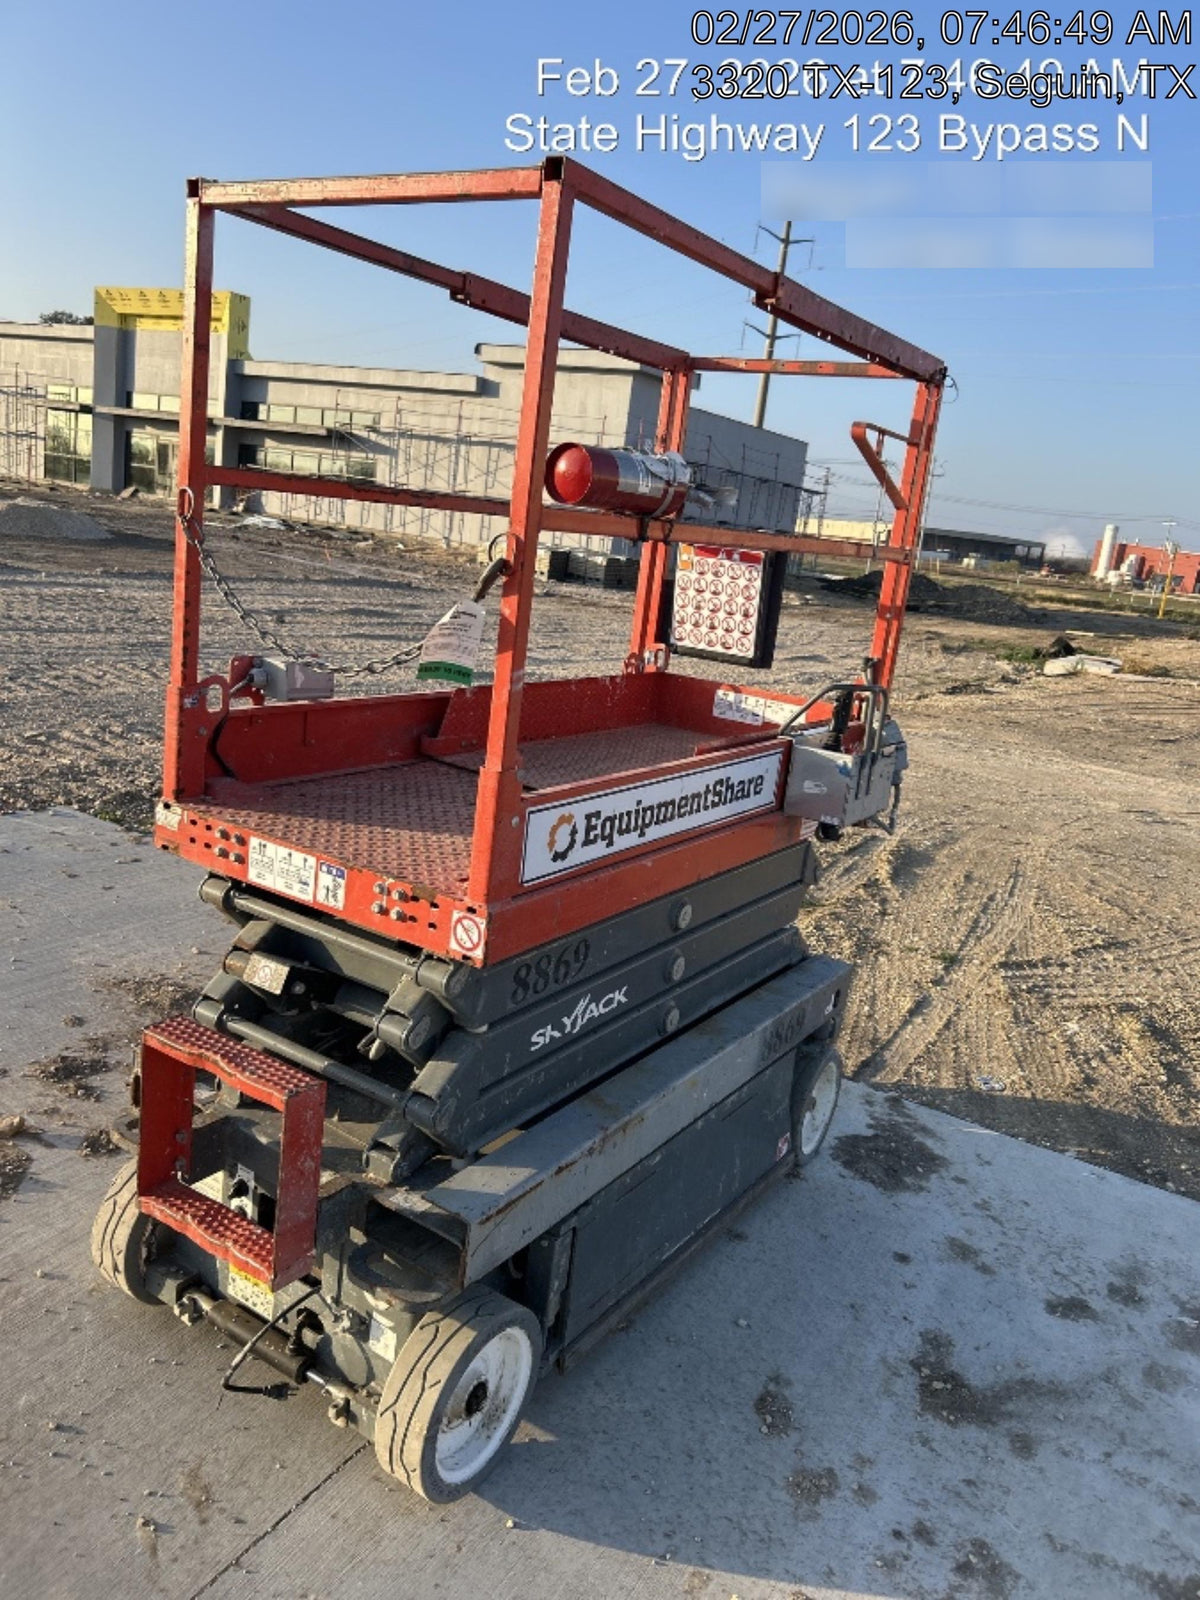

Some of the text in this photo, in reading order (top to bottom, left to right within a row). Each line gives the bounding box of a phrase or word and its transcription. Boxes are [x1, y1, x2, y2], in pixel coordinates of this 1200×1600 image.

[581, 773, 764, 849] EquipmentShare
[510, 938, 591, 1007] 8869
[530, 984, 629, 1052] SKYJACK
